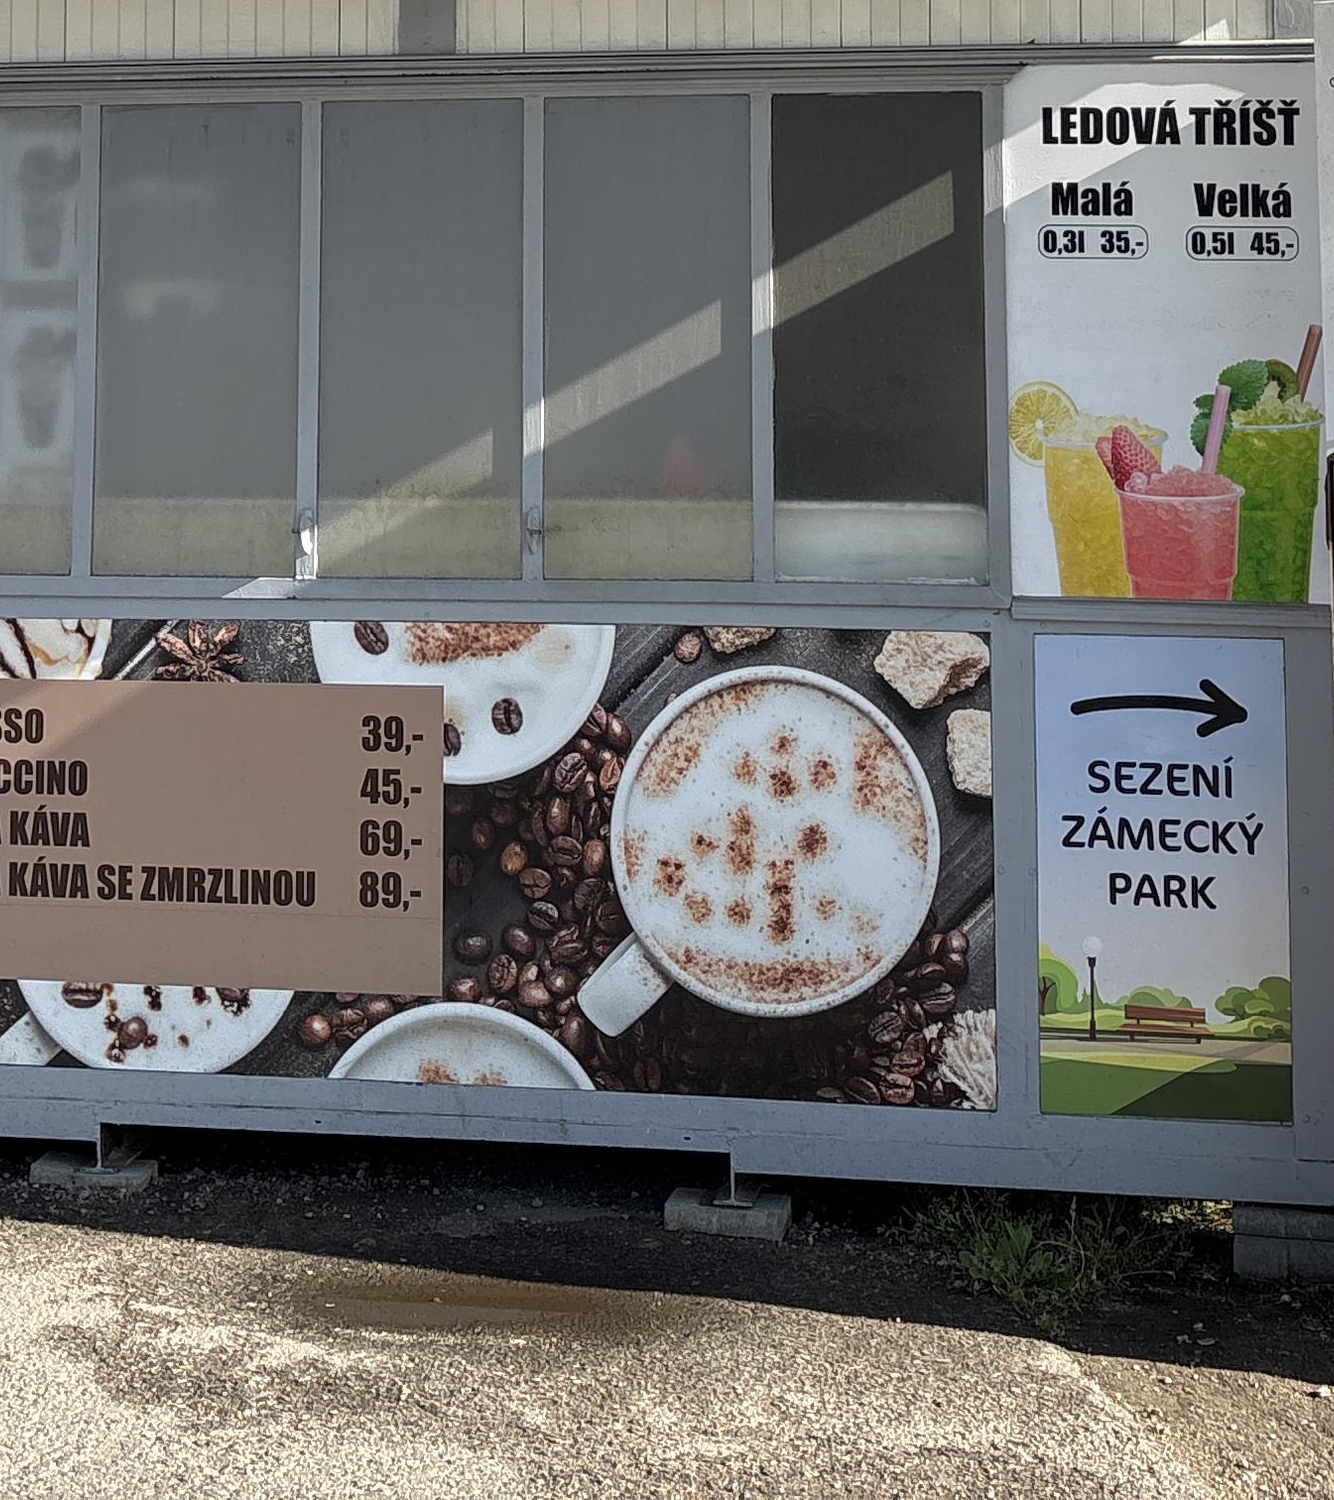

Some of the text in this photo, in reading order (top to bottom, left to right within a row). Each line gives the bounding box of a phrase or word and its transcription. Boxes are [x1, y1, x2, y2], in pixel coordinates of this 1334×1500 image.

[1042, 100, 1300, 146] LEDOVÁ TŘÍŠŤ
[1051, 181, 1133, 216] Malá
[1193, 182, 1292, 218] Velká
[1100, 231, 1144, 257] 35,-
[1250, 232, 1294, 258] 45,-
[361, 715, 424, 756] 39,-
[360, 769, 422, 809] 45,-
[1087, 756, 1233, 798] SEZENÍ
[9, 805, 91, 848] KÁVA
[359, 820, 423, 860] 69,-
[1061, 806, 1264, 855] ZÁMECKÝ
[8, 856, 89, 899] KÁVA
[97, 865, 132, 900] SE
[141, 866, 315, 907] ZMRZLINOU
[358, 871, 422, 911] 89,-
[1108, 872, 1217, 909] PARK
